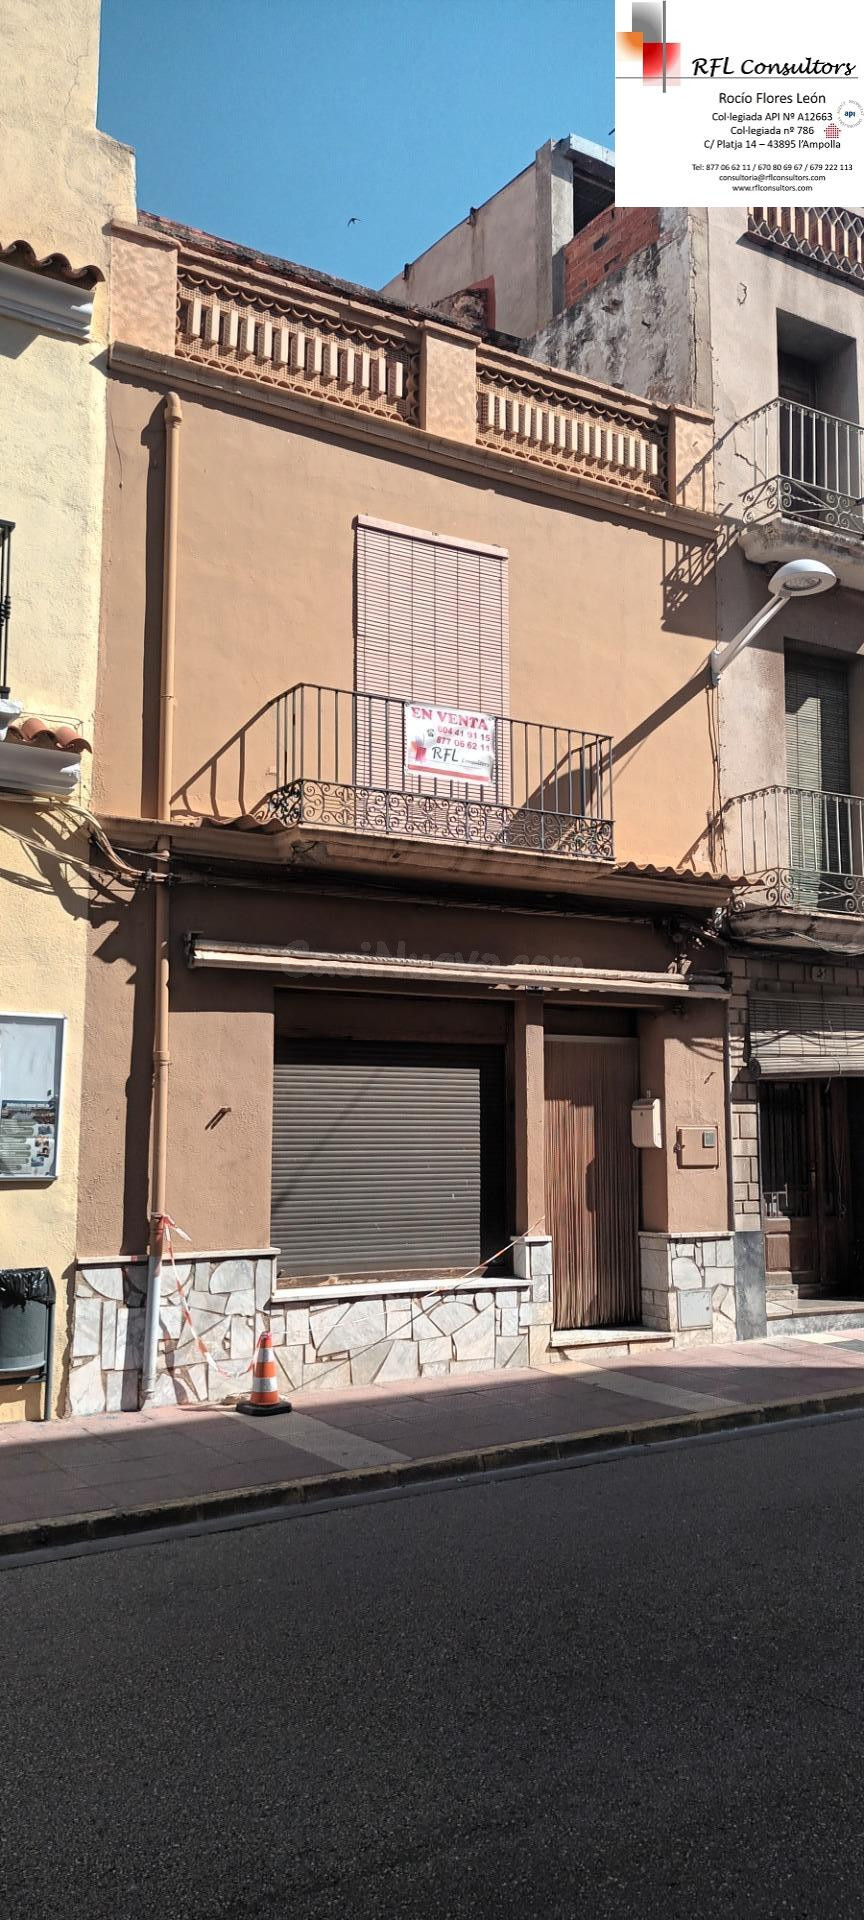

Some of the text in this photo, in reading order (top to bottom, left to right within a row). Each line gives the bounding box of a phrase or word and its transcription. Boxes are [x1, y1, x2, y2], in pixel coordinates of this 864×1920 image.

[411, 707, 488, 730] EN VENTA
[432, 746, 459, 762] RFL
